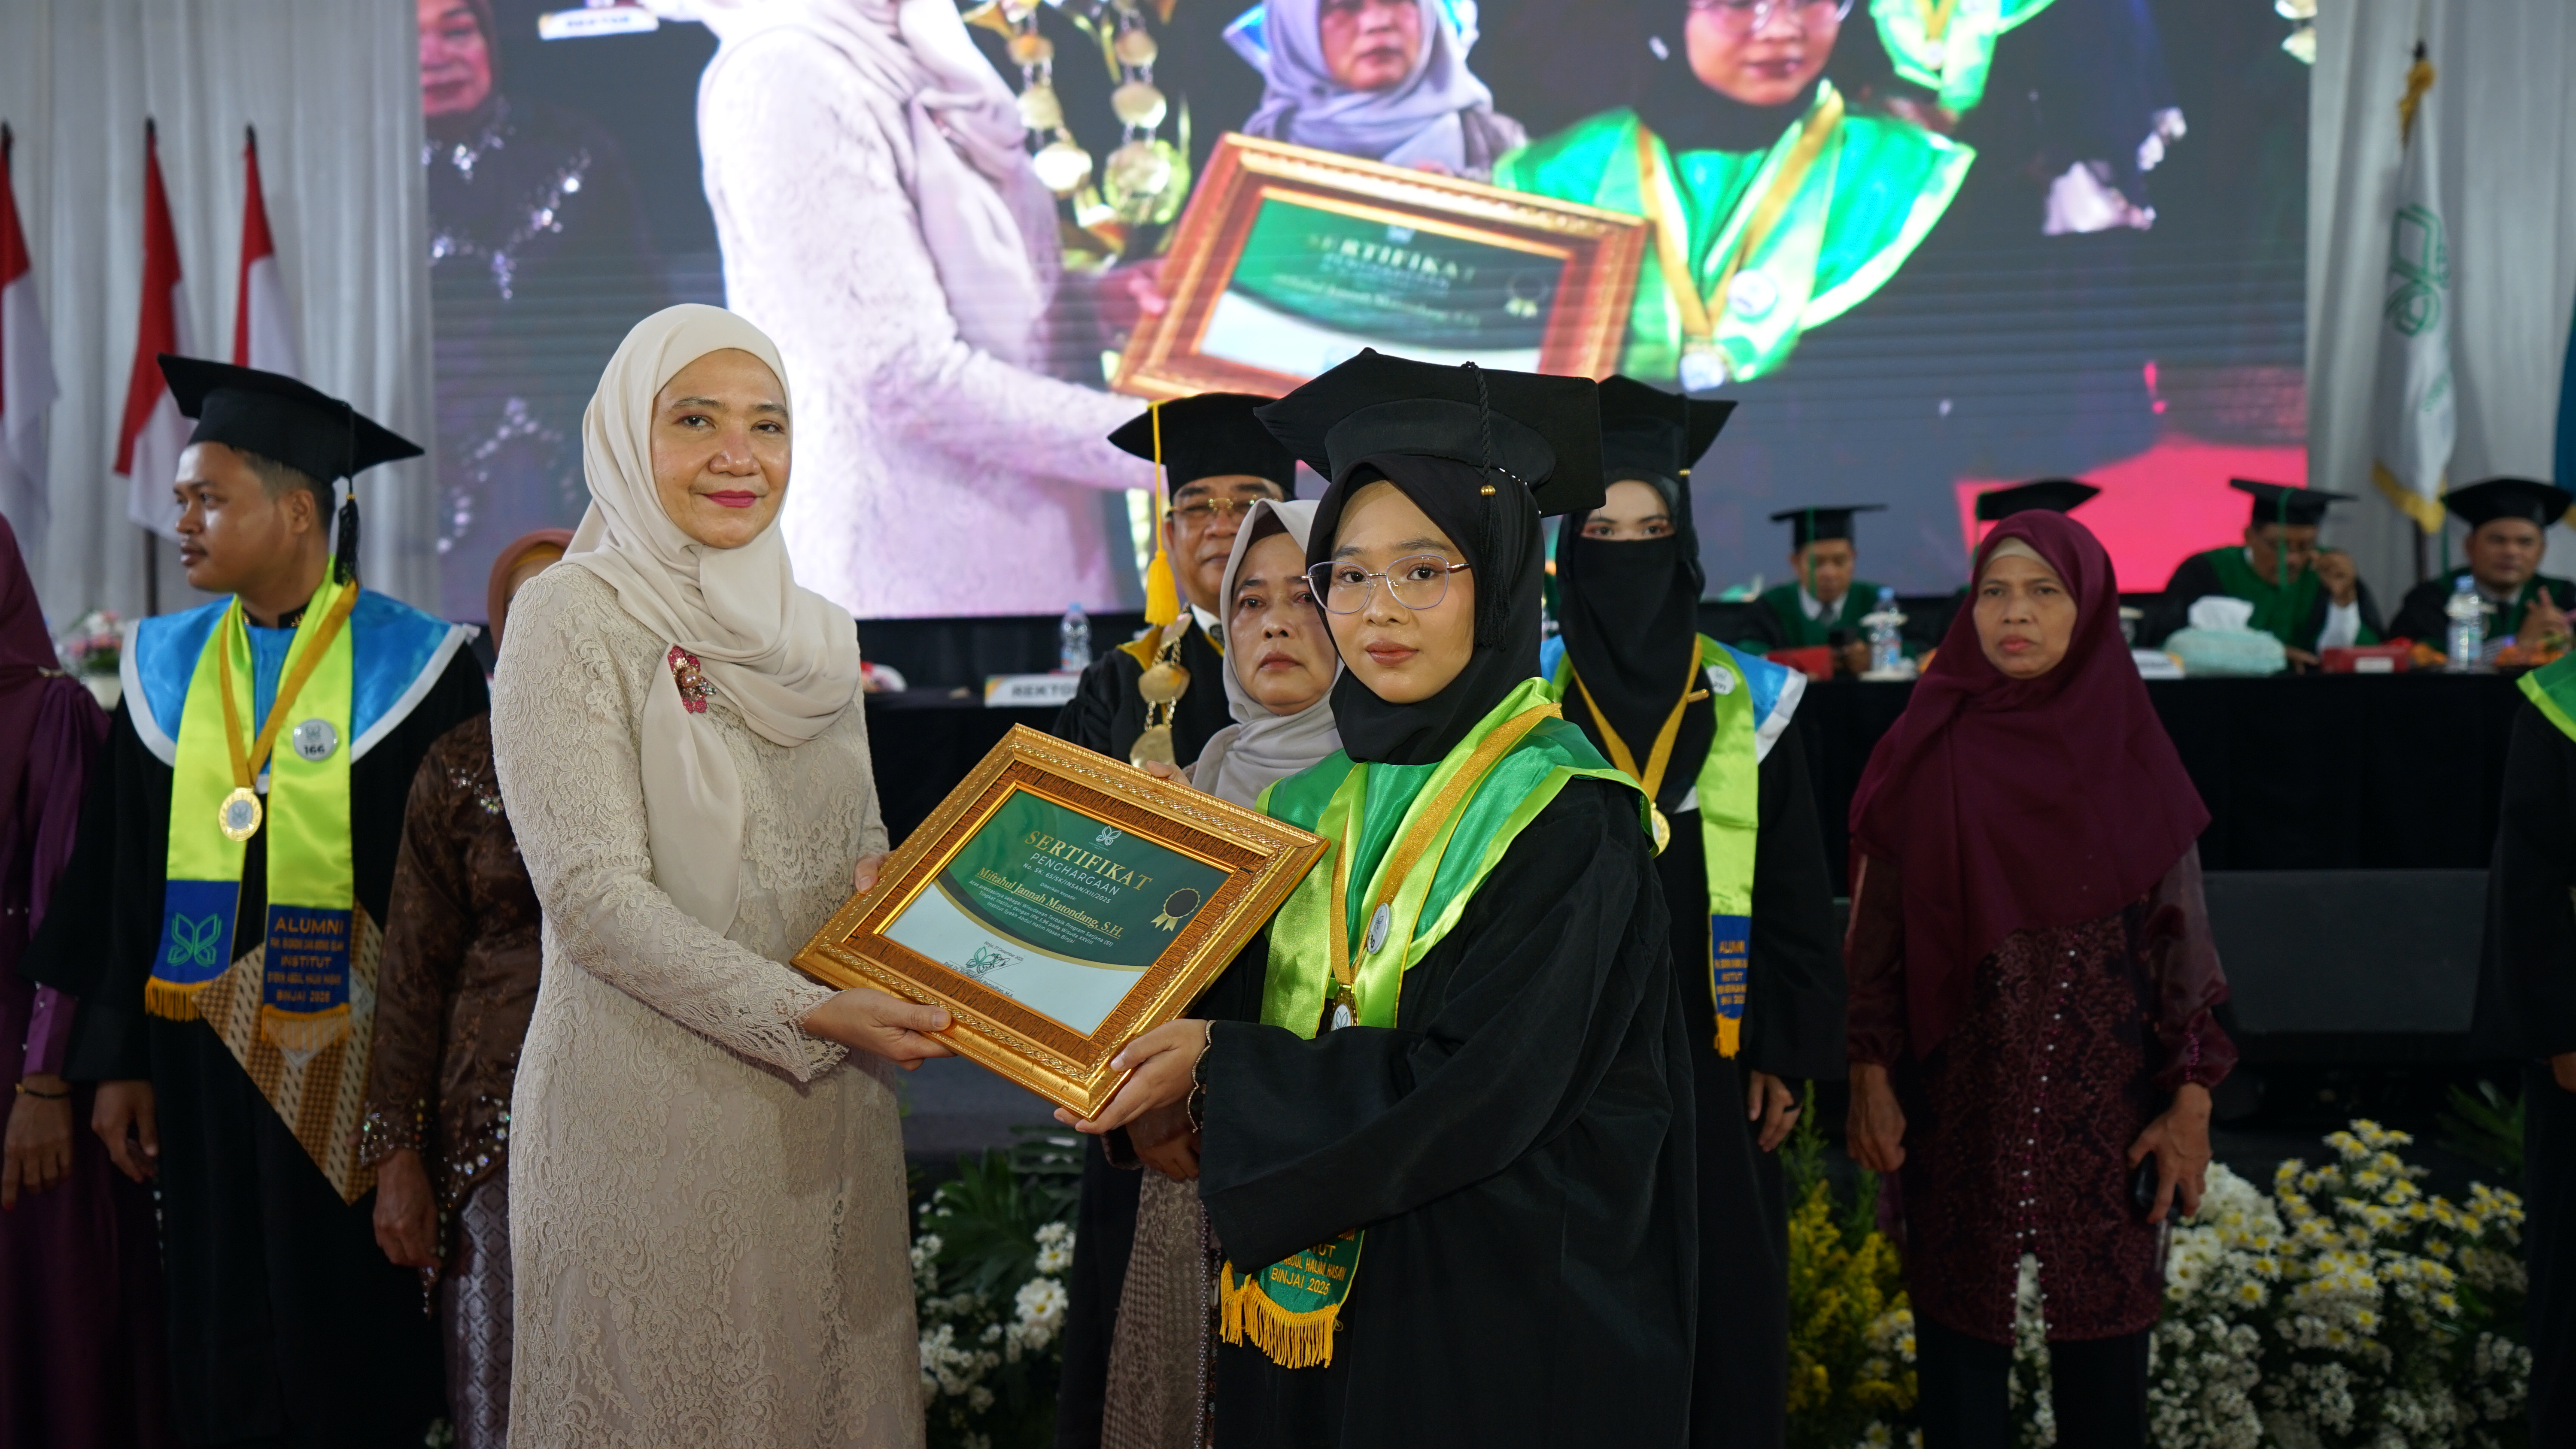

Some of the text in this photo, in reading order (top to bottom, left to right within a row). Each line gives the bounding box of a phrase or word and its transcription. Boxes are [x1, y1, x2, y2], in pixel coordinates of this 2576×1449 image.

[1012, 684, 1076, 697] REKTO
[304, 744, 325, 755] 166
[1024, 831, 1153, 891] SERTIFIKAT
[1030, 852, 1120, 896] PENGHARGAAN
[1034, 867, 1045, 876] SK:
[1045, 872, 1112, 903] 65/SK/INSAN/XII/2025
[1040, 882, 1077, 901] Diberikan Kepada:
[976, 867, 1124, 937] Miftahul Jannah Matondang, S.H.
[978, 884, 1005, 898] prestasinya
[1004, 895, 1022, 906] sebagai
[1022, 903, 1048, 918] Wisudawan
[1048, 914, 1066, 925] Terbaik
[1065, 922, 1086, 934] Program
[1085, 931, 1104, 943] Sarjana
[979, 890, 996, 901] Tingkat
[996, 898, 1013, 909] Institut
[1012, 905, 1030, 916] dengan
[1048, 922, 1060, 931] pada
[1061, 927, 1078, 938] Wisuda
[1078, 935, 1094, 945] XXVIII
[274, 916, 344, 934] ALUMNI
[987, 901, 1075, 944] Institut Syekh Abdul Halim Hasan Binjai
[281, 955, 332, 968] INSTITUT
[1270, 1267, 1331, 1295] BINJAI 2025
[1305, 1258, 1327, 1277] HALIM
